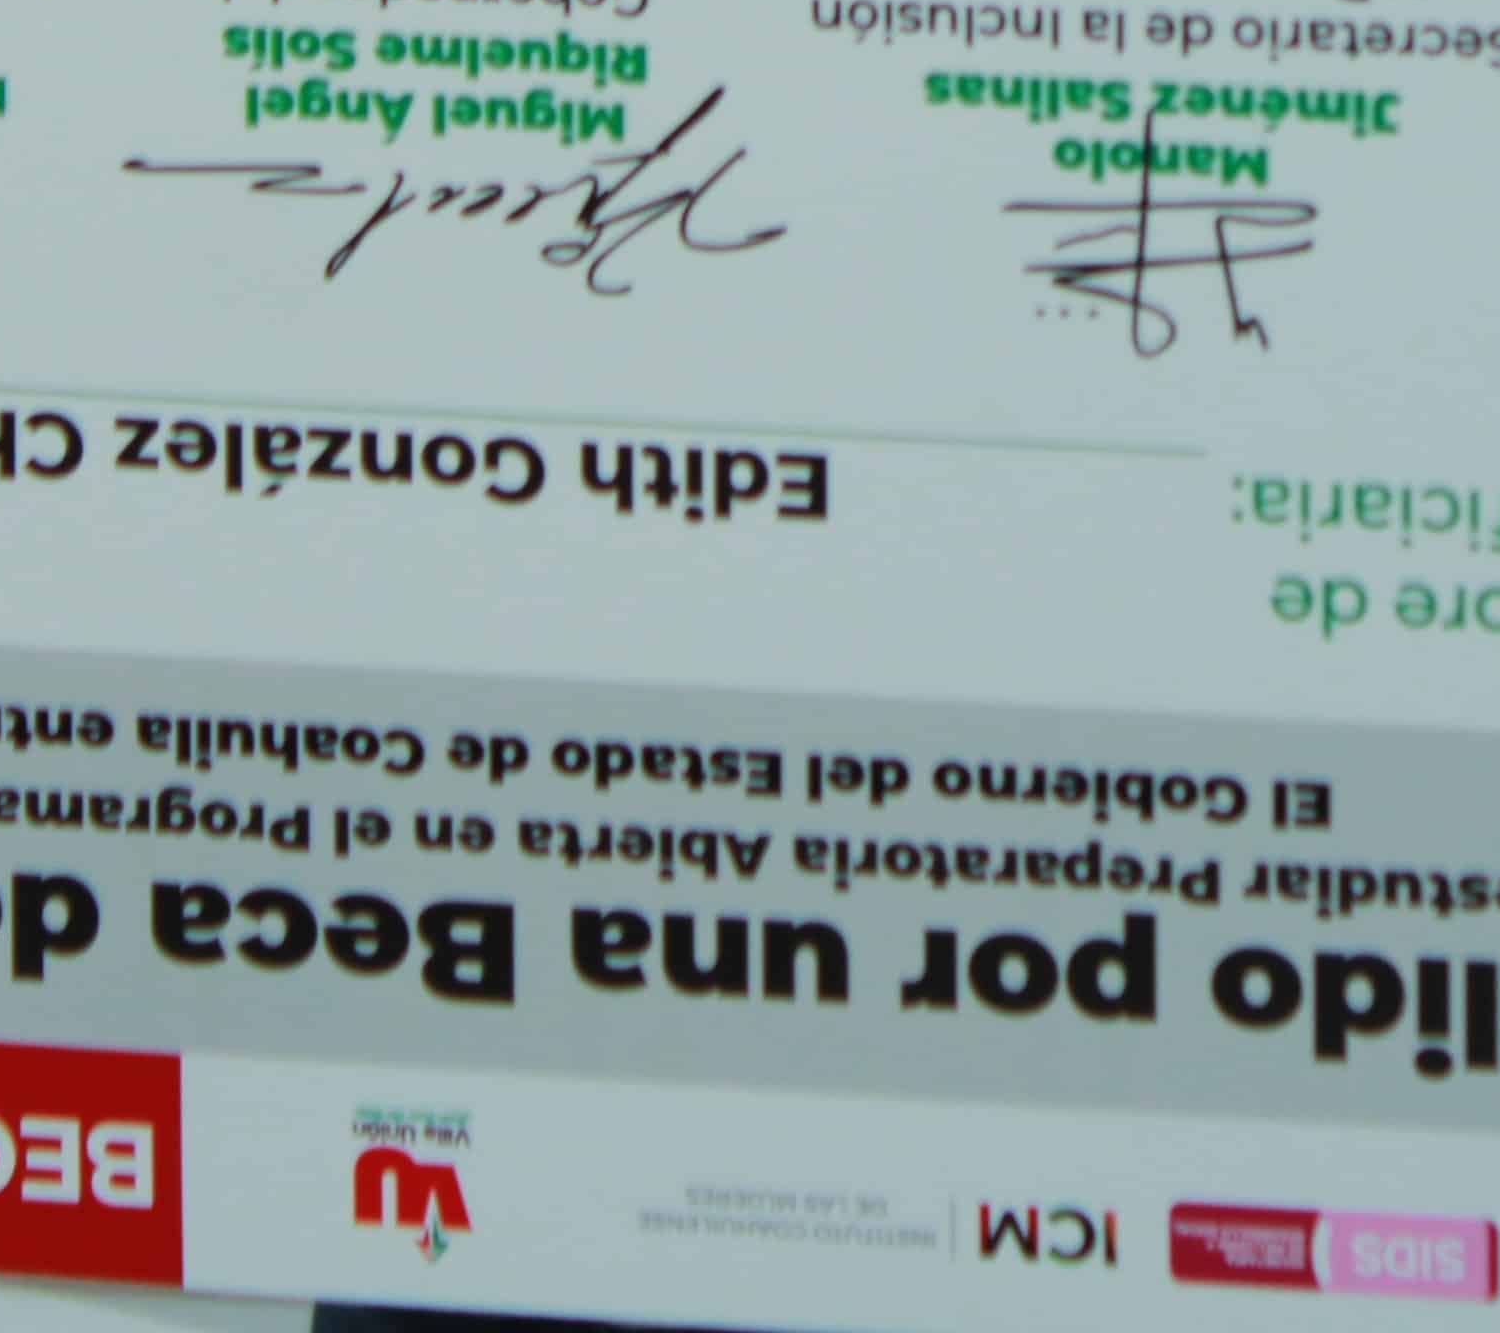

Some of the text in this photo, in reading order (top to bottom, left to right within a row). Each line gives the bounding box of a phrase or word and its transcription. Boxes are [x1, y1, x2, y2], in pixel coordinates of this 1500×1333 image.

[222, 25, 648, 89] Riquelme Solís
[1094, 9, 1132, 55] la
[1145, 11, 1215, 57] de
[245, 76, 625, 146] Miguel Ángel
[924, 72, 1400, 145] Jiménez Salinas
[1053, 122, 1268, 198] Manolo
[115, 417, 545, 504] González
[581, 443, 827, 522] Edith
[1270, 574, 1369, 641] de
[137, 714, 425, 776] Coahuila
[448, 733, 529, 784] de
[551, 739, 782, 797] Estado
[807, 754, 910, 806] del
[932, 761, 1248, 824] Gobierno
[1273, 780, 1331, 829] El
[334, 808, 391, 857] el
[415, 813, 495, 853] en
[518, 820, 771, 881] Abierta
[793, 836, 1221, 906] Preparatoria
[152, 882, 515, 1004] Beca
[572, 908, 849, 1002] una
[901, 912, 1156, 1019] por
[979, 1203, 1117, 1266] ICM
